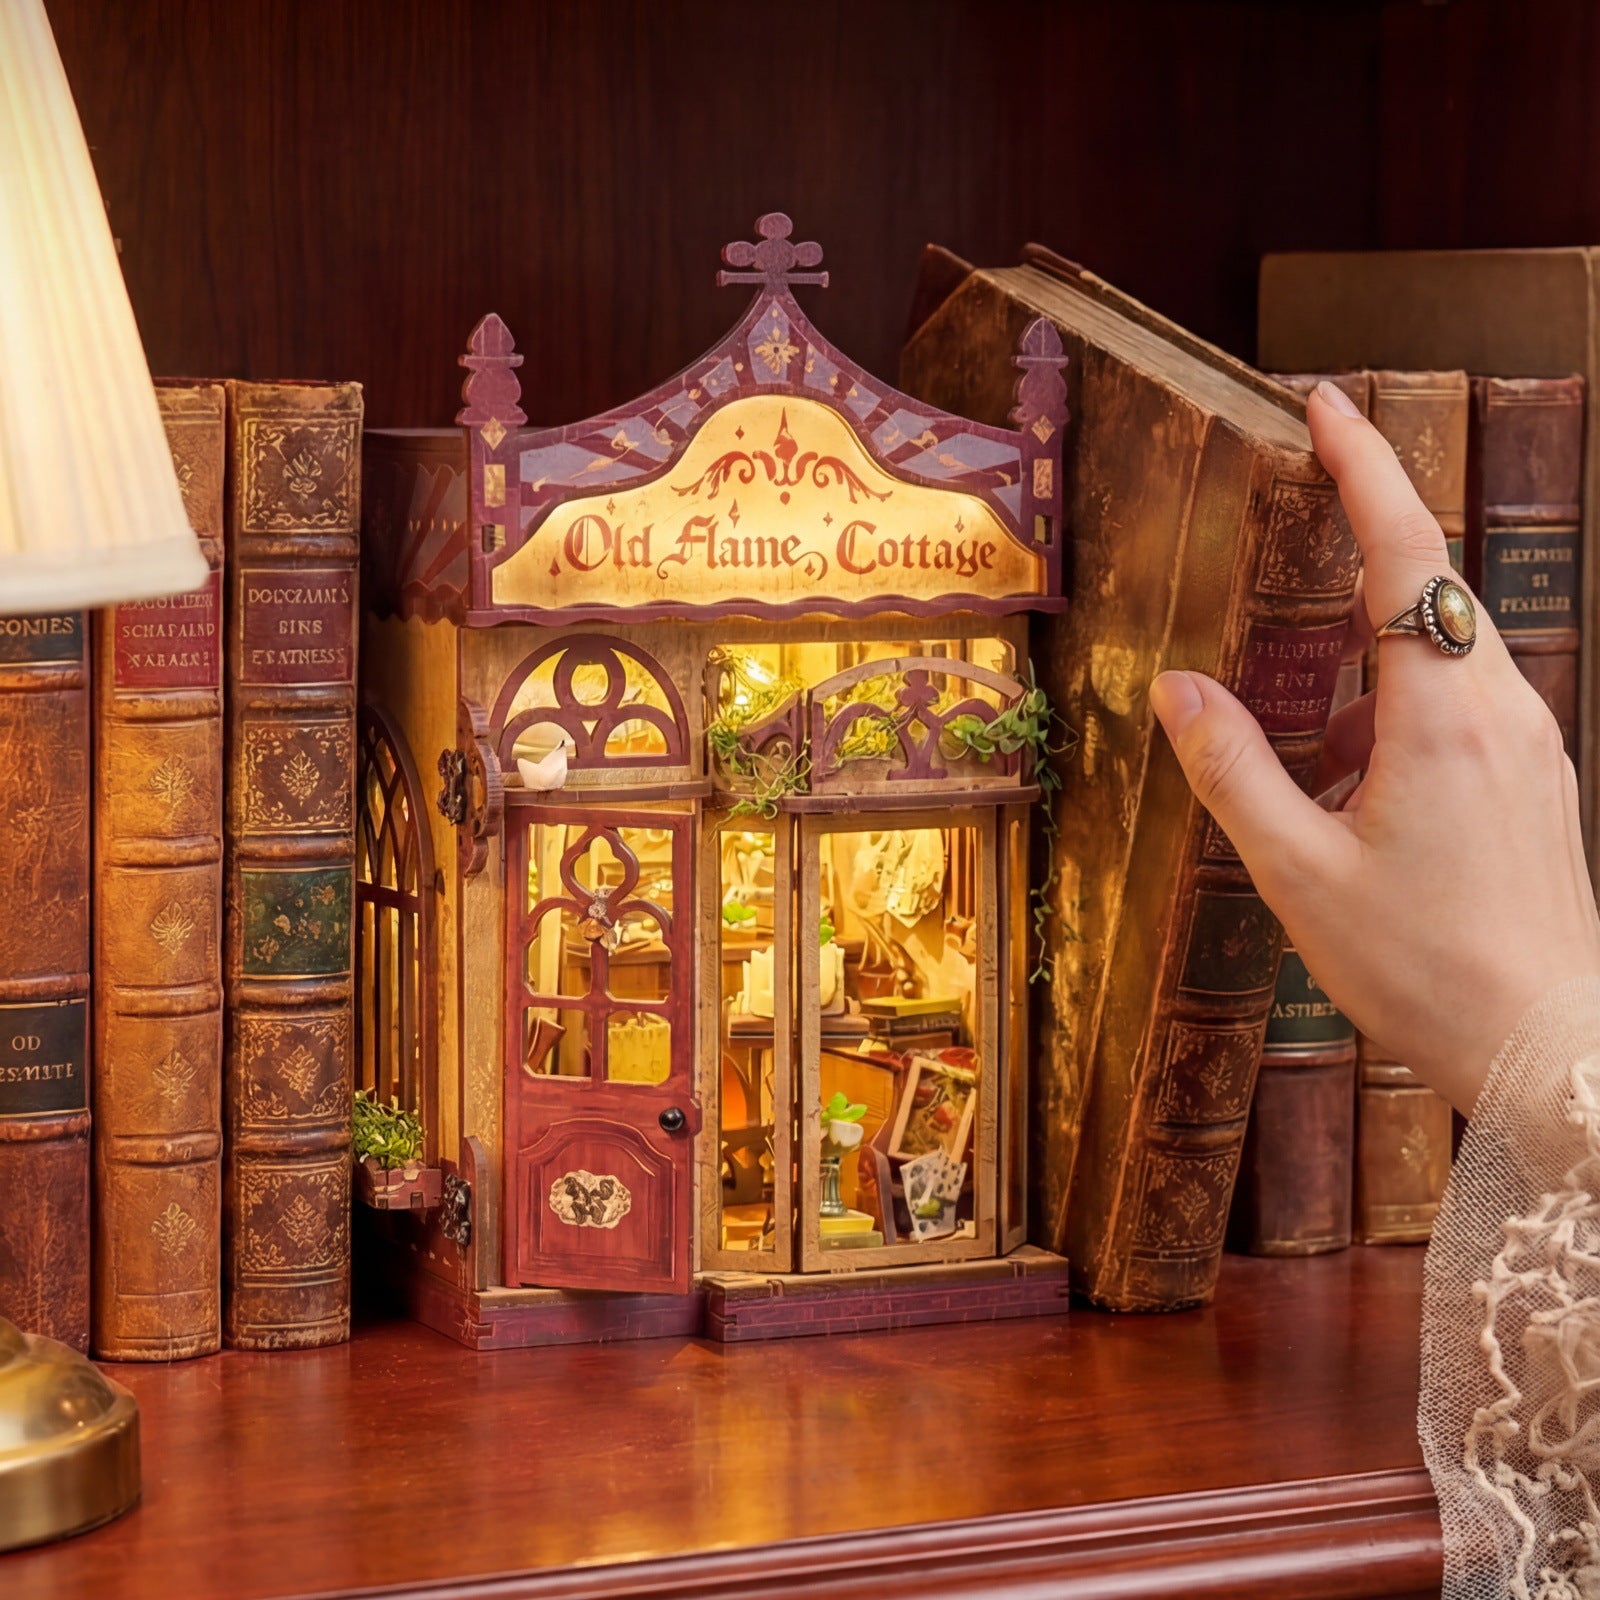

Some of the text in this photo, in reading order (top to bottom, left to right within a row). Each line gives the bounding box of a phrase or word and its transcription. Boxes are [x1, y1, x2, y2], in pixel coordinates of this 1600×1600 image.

[563, 513, 997, 581] Old Flame Cottage
[11, 1034, 42, 1052] OD
